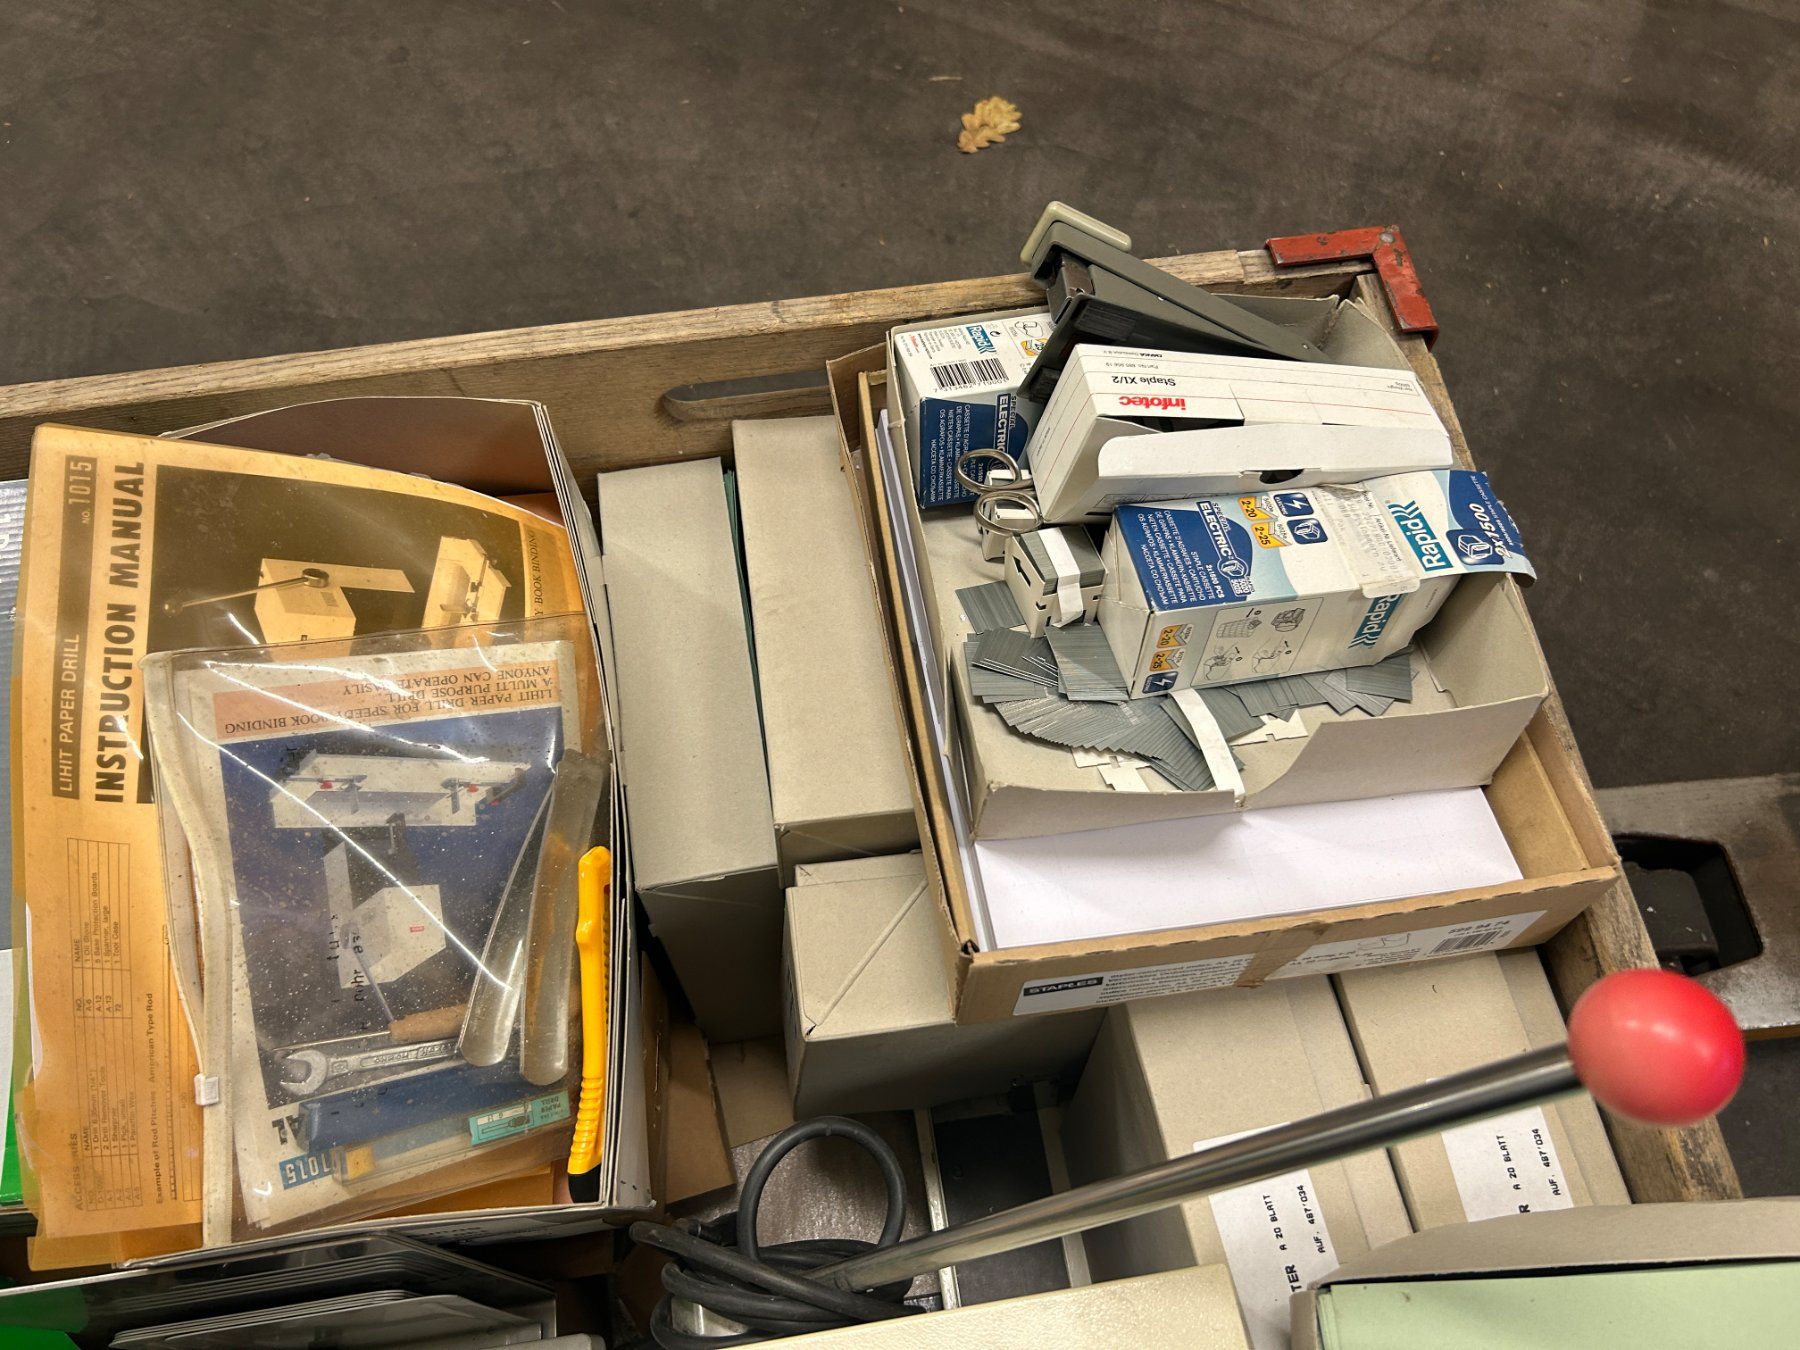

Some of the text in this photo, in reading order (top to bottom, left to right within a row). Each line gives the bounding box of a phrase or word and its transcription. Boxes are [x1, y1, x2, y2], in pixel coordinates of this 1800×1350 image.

[969, 326, 990, 347] Rapid
[1139, 376, 1176, 385] Staple
[956, 406, 961, 414] DE
[1118, 396, 1186, 409] infotec
[996, 395, 1008, 452] ELECTRIC
[68, 460, 92, 523] NO. 1015
[1241, 500, 1257, 516] 2-20
[1199, 503, 1231, 555] ELECTRIC
[1254, 527, 1270, 544] 2-25
[1468, 504, 1511, 557] 2x1500
[1399, 516, 1446, 568] Rapid
[1163, 511, 1179, 533] CASSETTE
[1187, 570, 1206, 599] CARTUCHO
[1153, 533, 1170, 558] CASSETTE
[1176, 589, 1187, 601] PARA
[1189, 552, 1215, 598] STAPLE CASSETTE
[533, 575, 542, 603] BOOK
[1214, 586, 1225, 597] PCS
[1362, 594, 1399, 632] Rapid
[89, 460, 149, 803] INSTRUCTION MANUAL
[1160, 629, 1172, 645] 2-20
[1152, 654, 1164, 668] 2-25
[455, 670, 491, 683] CAN
[496, 664, 550, 679] ANYONE
[397, 674, 450, 689] OPERATE
[430, 682, 490, 698] PURPOSE
[495, 678, 536, 691] MULTI
[470, 692, 512, 706] PAPER
[517, 687, 552, 701] LIHIT
[57, 633, 80, 791] LIHIT PAPER DRILL
[392, 701, 419, 714] FOR
[423, 696, 464, 711] DRILL
[336, 704, 387, 721] SPEEDY
[224, 716, 286, 734] BINDING
[1029, 978, 1097, 993] STAPLES
[145, 992, 153, 1011] Rod
[146, 1013, 154, 1036] Type
[150, 1127, 159, 1147] Rod
[152, 1149, 159, 1159] of
[1495, 1133, 1511, 1162] BLATT
[1507, 1166, 1517, 1179] 20
[153, 1161, 162, 1204] Example
[1262, 1193, 1278, 1222] BLATT
[1296, 1184, 1315, 1224] 487'034
[1273, 1226, 1283, 1238] 20
